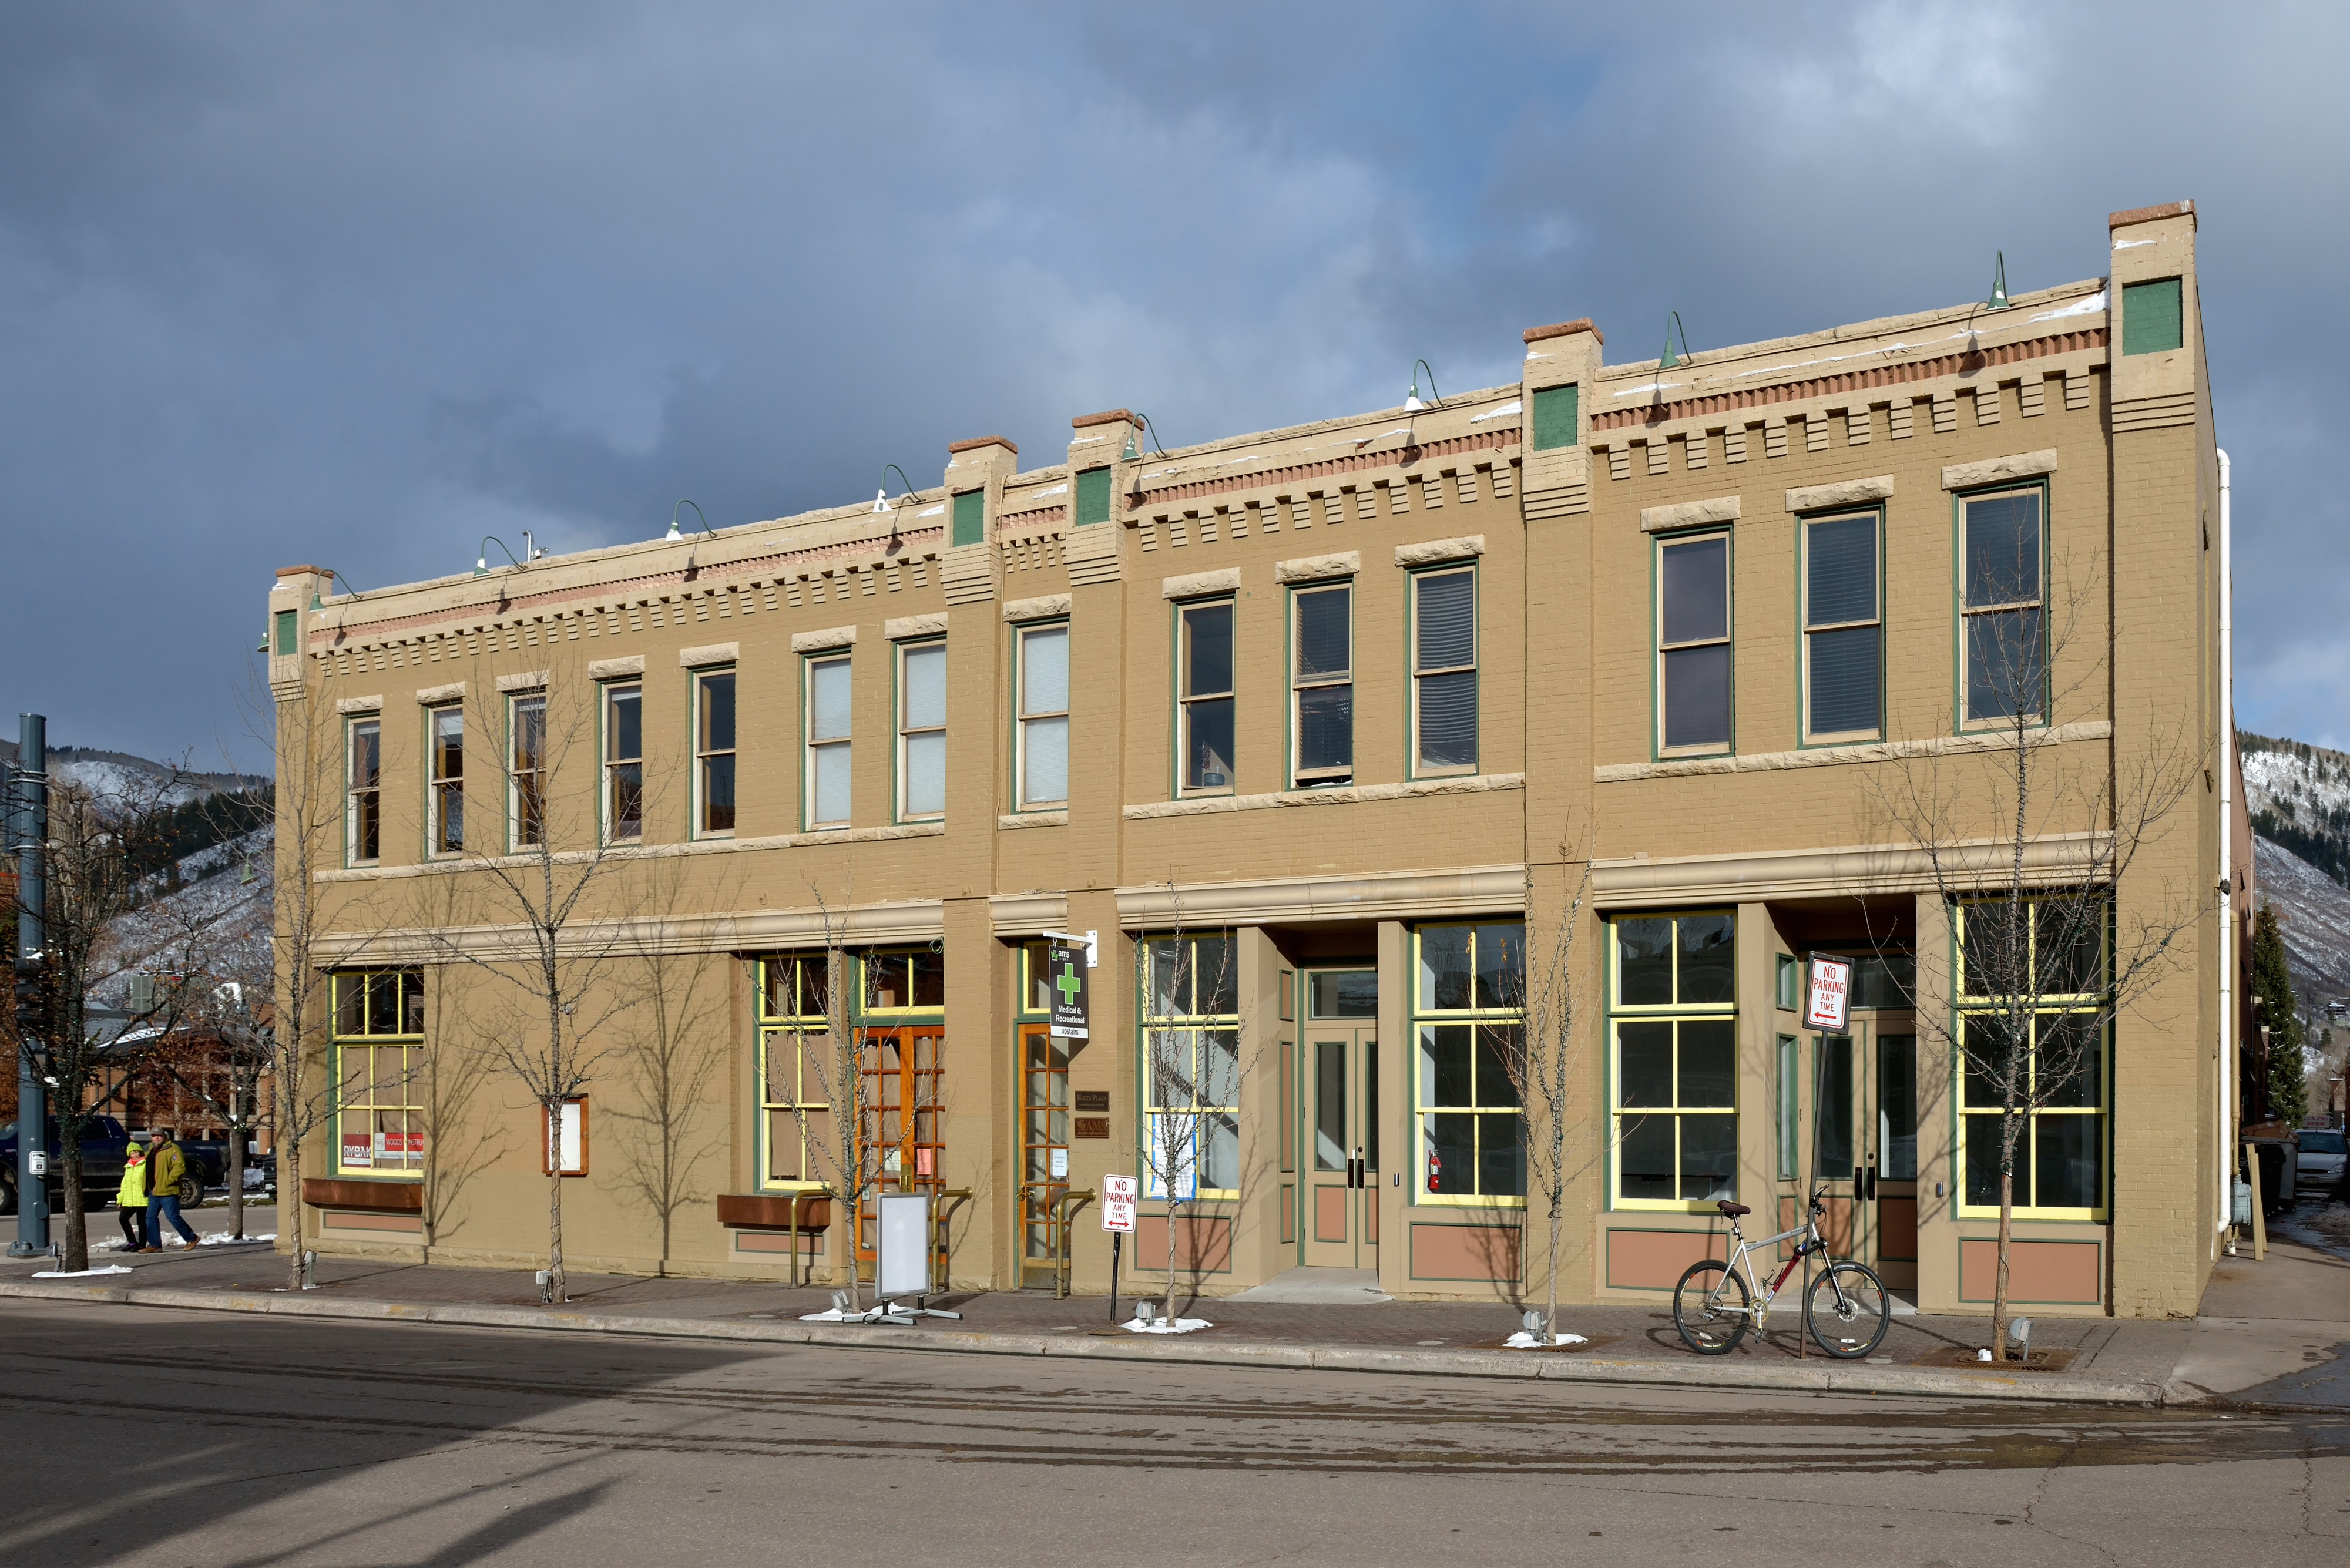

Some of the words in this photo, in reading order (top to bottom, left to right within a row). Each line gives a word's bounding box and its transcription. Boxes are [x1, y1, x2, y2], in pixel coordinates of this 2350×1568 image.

[1058, 950, 1070, 958] ams
[1824, 966, 1836, 979] NO
[1814, 978, 1844, 994] PARKING
[1821, 992, 1835, 1002] ANY
[1058, 1005, 1076, 1014] Medical
[1819, 1002, 1834, 1012] TIME
[1056, 1014, 1085, 1024] Recreational
[1114, 1181, 1127, 1191] NO
[1106, 1192, 1134, 1204] PARKING
[1112, 1212, 1127, 1220] TIME
